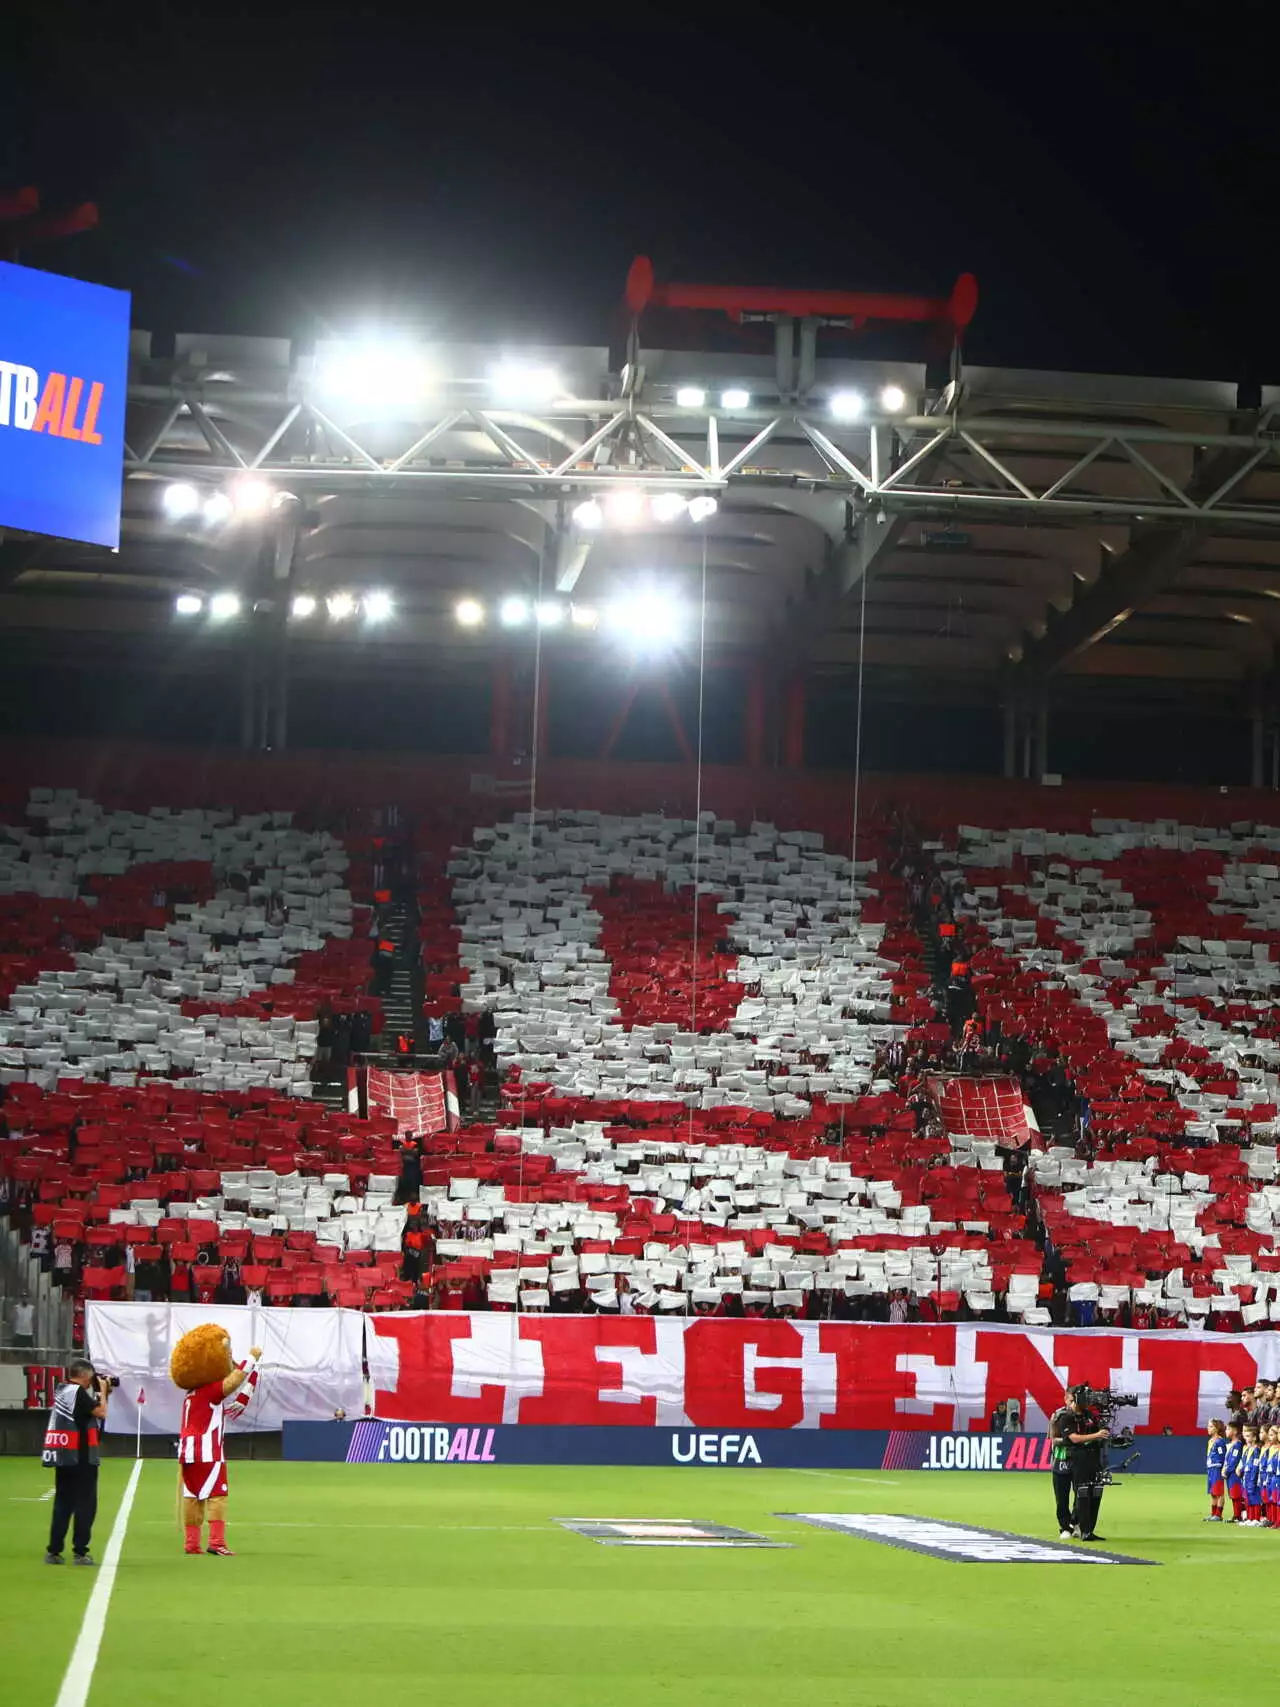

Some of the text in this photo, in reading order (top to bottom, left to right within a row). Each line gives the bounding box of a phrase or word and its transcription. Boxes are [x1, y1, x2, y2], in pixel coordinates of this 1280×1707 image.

[672, 1433, 762, 1464] UEFA
[922, 1435, 1053, 1469] LCOME ALL
